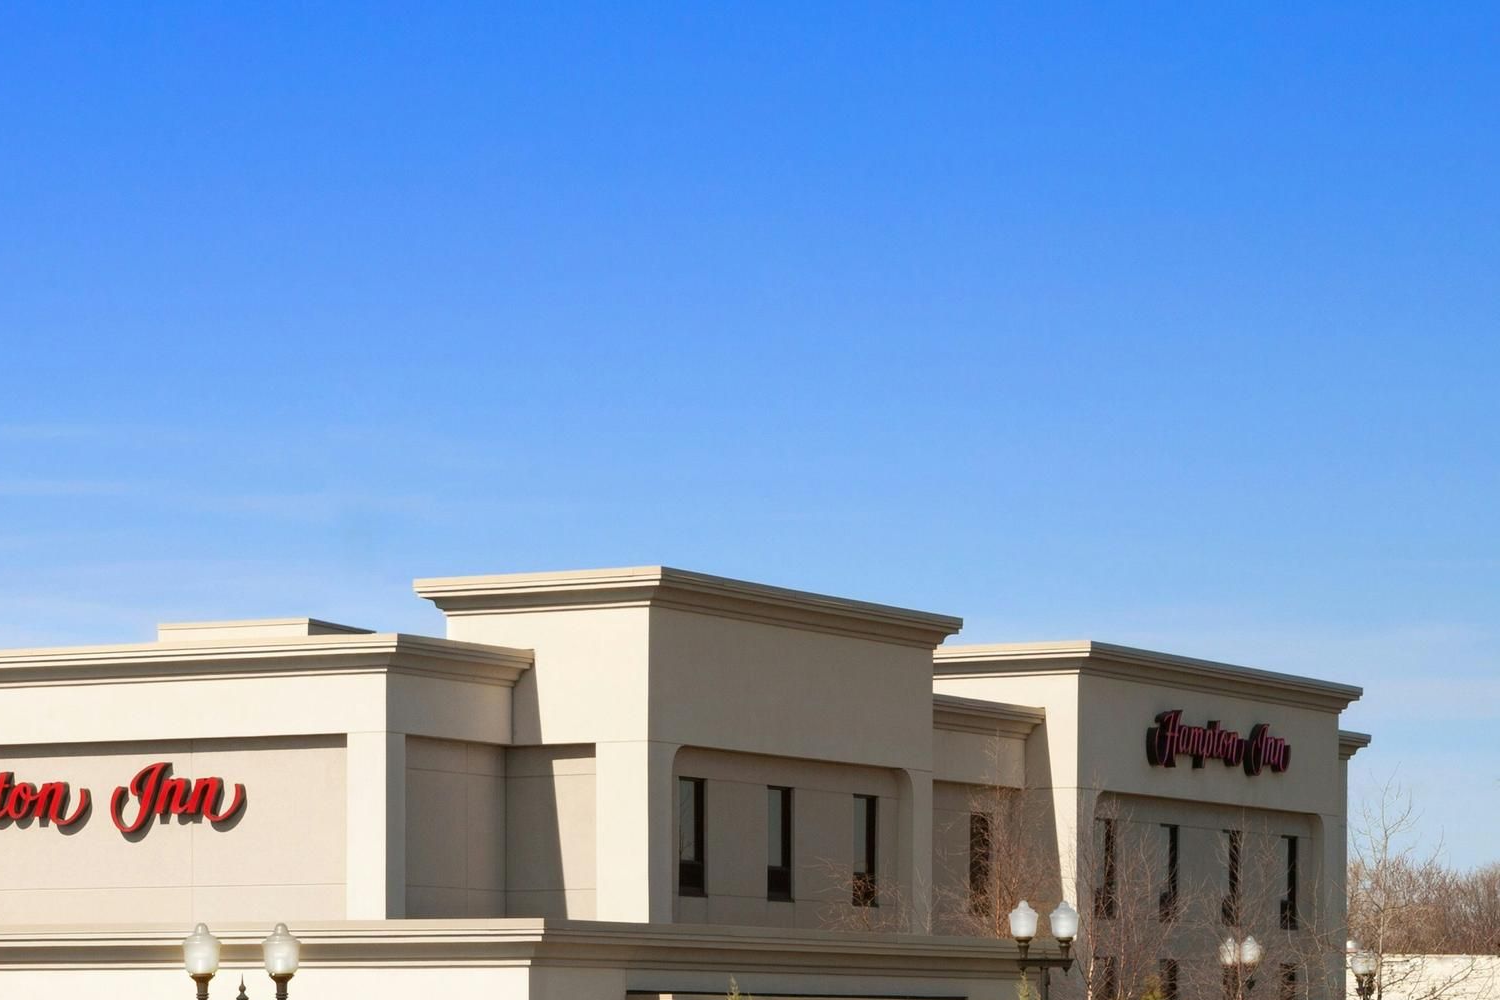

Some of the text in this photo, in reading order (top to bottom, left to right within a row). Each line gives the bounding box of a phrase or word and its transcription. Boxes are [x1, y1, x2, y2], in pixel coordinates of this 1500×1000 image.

[1148, 710, 1291, 776] Hampton Inn
[111, 762, 247, 836] Inn
